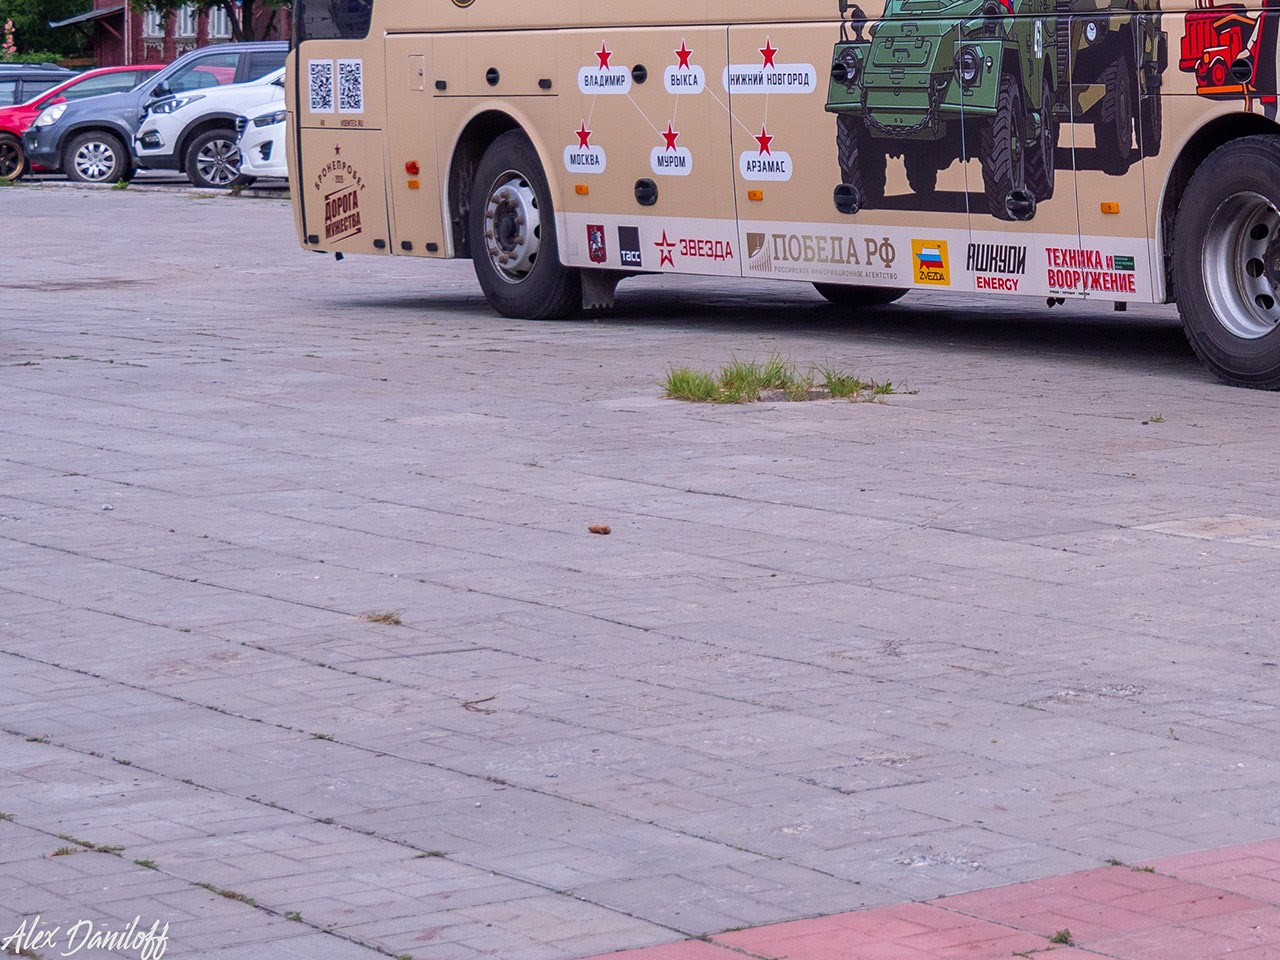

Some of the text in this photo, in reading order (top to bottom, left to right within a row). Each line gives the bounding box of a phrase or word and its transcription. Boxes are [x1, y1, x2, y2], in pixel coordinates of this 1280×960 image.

[584, 75, 626, 88] ВЛАДИМИР
[671, 75, 699, 87] ВЫКСА
[730, 71, 810, 87] НИЖНИЙ НОВГОРОД
[570, 154, 600, 166] МОСКВА
[657, 155, 686, 168] МУРОМ
[746, 160, 786, 173] АРЗАМАС
[325, 190, 359, 225] ДОРОГА
[326, 211, 361, 239] МУЖЕСТВА
[680, 239, 733, 261] ЗВЕЗДА
[772, 233, 896, 268] ПОБЕДА РФ
[1045, 247, 1103, 271] ТЕХНИКА
[919, 271, 945, 281] ZVEZDA
[977, 276, 1019, 291] ENERGY
[1048, 269, 1136, 293] ВООРУЖЕНИЕ
